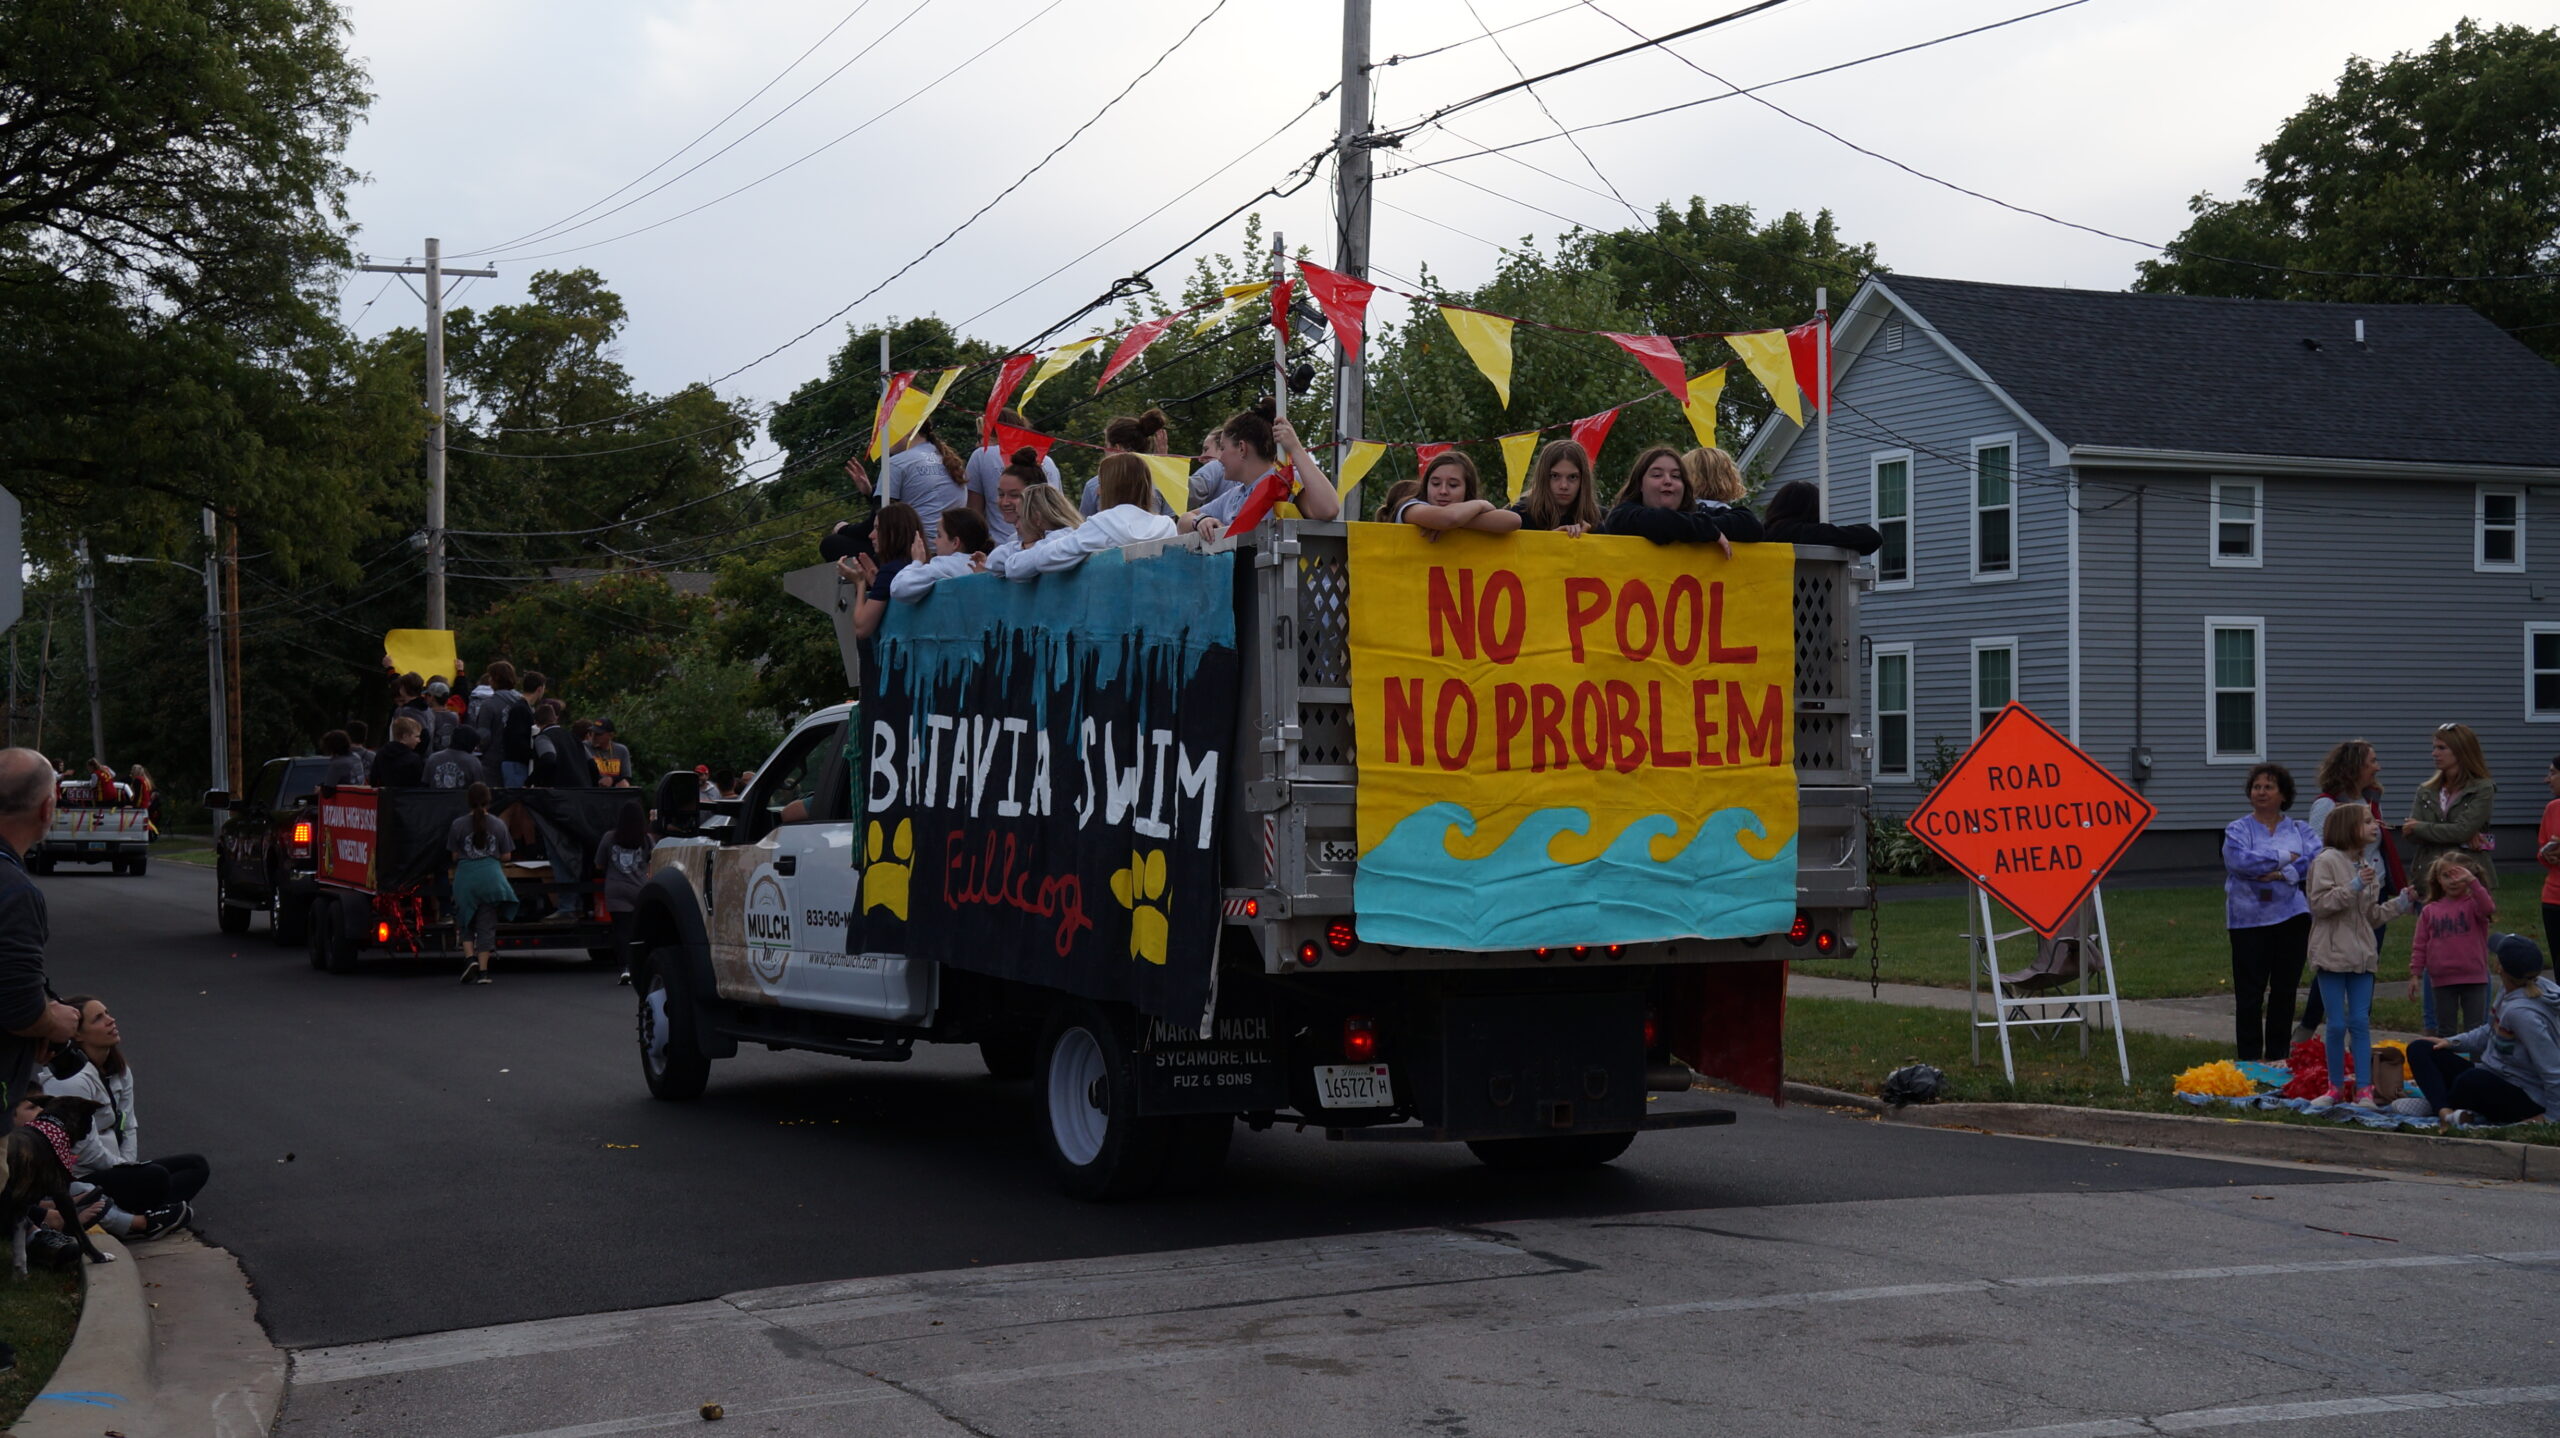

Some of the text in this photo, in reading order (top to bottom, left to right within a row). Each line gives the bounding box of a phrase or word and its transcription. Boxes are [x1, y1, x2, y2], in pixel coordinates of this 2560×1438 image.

[1428, 565, 1758, 666] NO POOL
[1383, 676, 1783, 774] NO PROBLEM
[867, 713, 1220, 850] BATAVIA SWIM
[1988, 762, 2061, 791] ROAD
[1926, 799, 2132, 836] CONSTRUCTION
[1994, 844, 2083, 875] AHEAD
[747, 913, 791, 941] MULCH
[806, 909, 852, 928] 833-GO-M
[1219, 1016, 1272, 1041] MACH.
[1202, 1074, 1212, 1087] &
[1216, 1072, 1253, 1087] SONS
[1325, 1077, 1388, 1098] 165727 H
